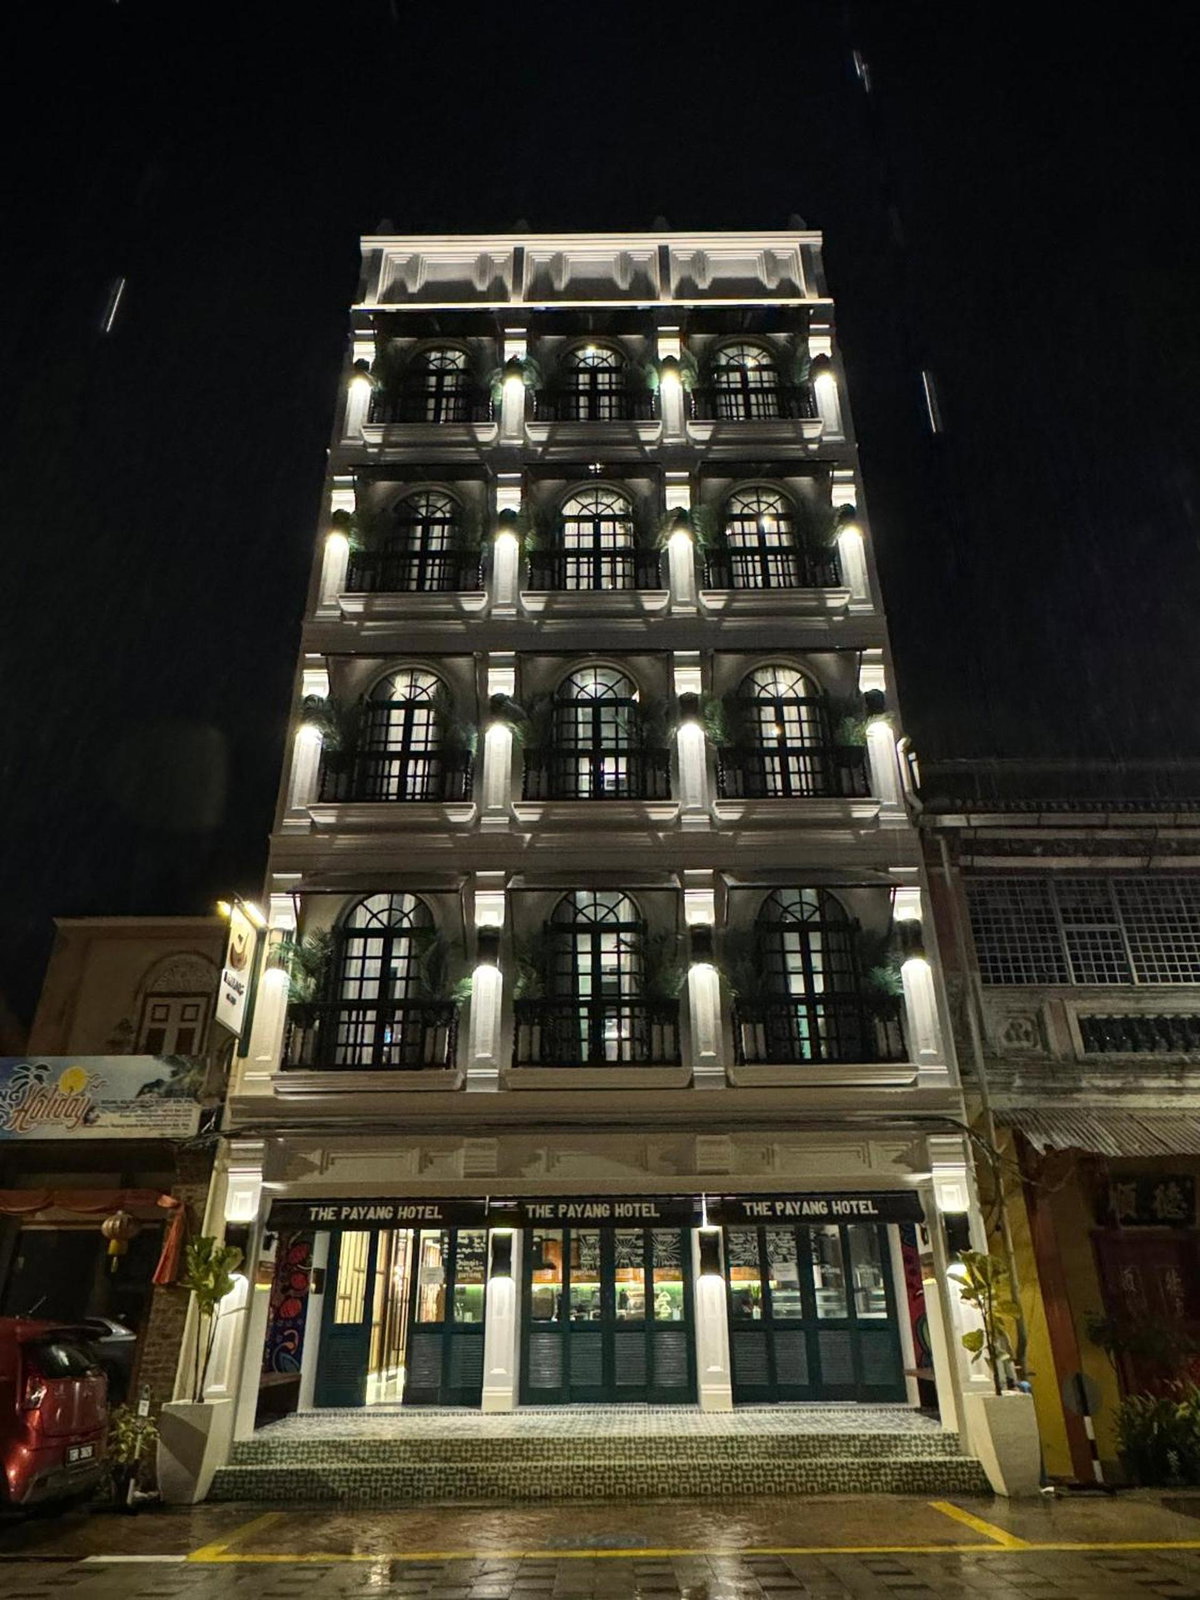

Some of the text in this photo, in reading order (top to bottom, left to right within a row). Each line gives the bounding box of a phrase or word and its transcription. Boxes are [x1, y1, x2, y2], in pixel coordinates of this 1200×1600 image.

[309, 1206, 443, 1220] THE PAYANG HOTEL
[525, 1203, 660, 1218] THE PAYANG HOTEL
[742, 1200, 879, 1216] THE PAYANG HOTEL
